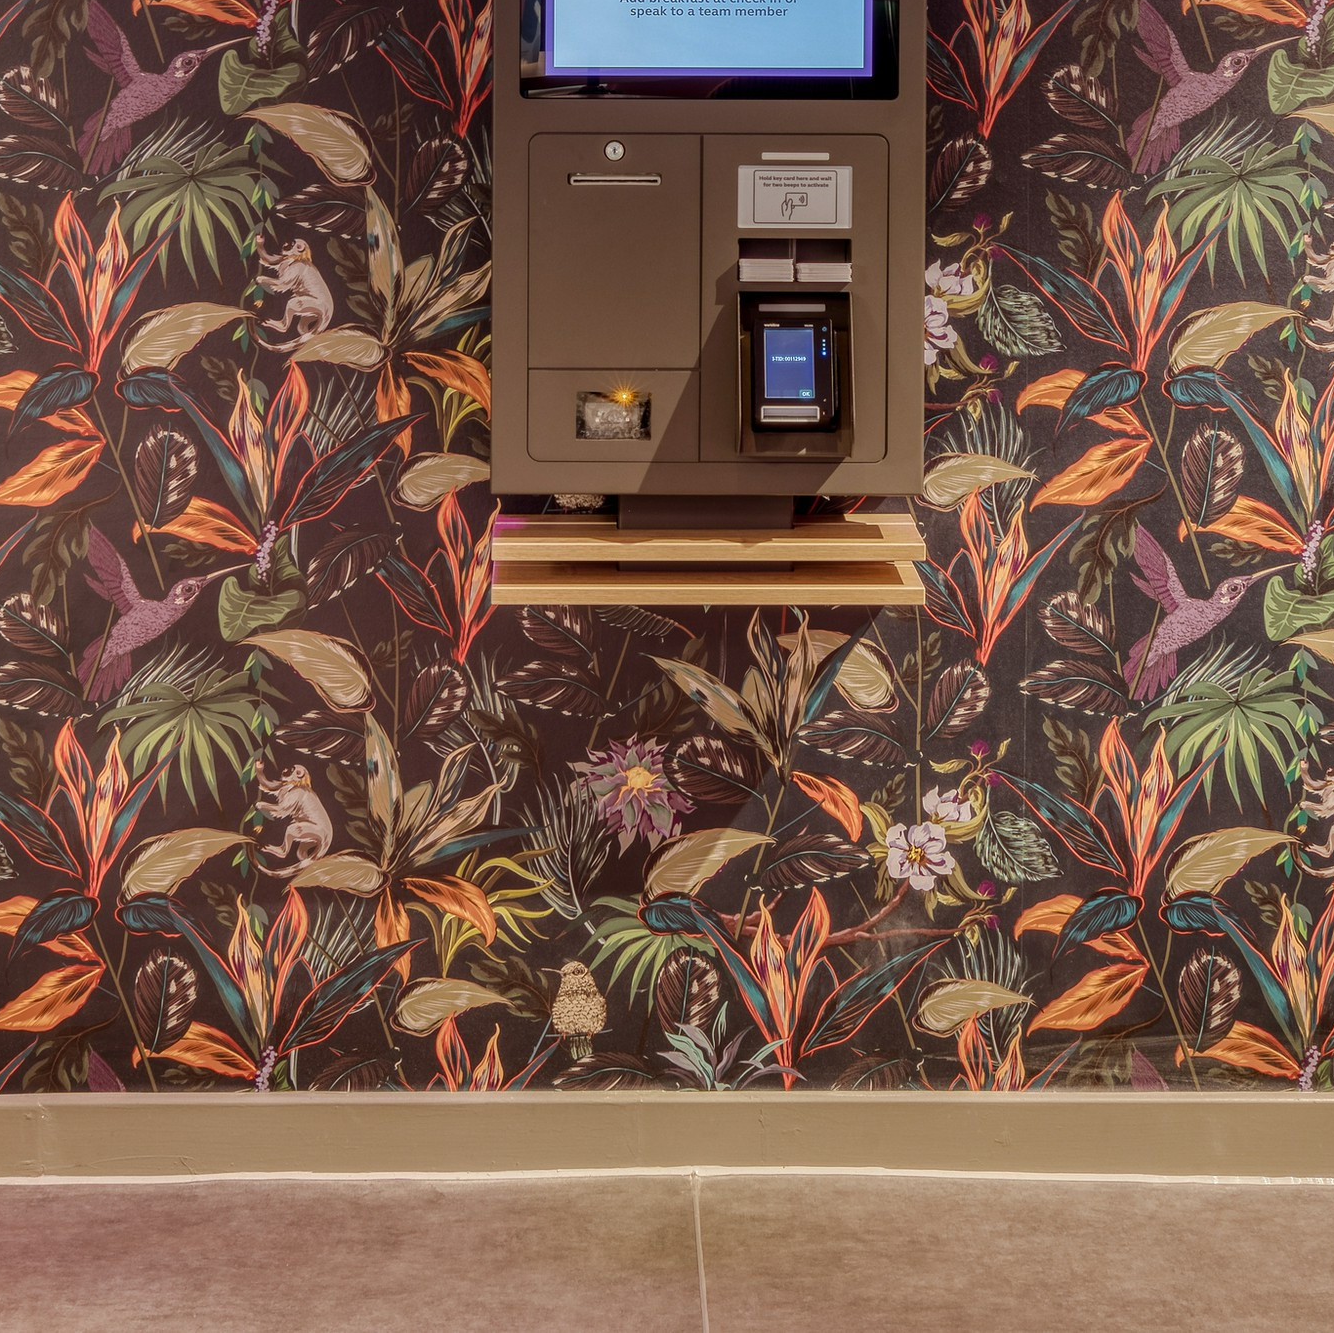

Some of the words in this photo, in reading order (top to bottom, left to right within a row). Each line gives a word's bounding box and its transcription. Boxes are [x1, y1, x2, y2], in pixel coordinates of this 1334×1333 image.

[631, 6, 666, 18] speak
[671, 7, 683, 15] to
[699, 7, 730, 15] team
[735, 6, 787, 15] member
